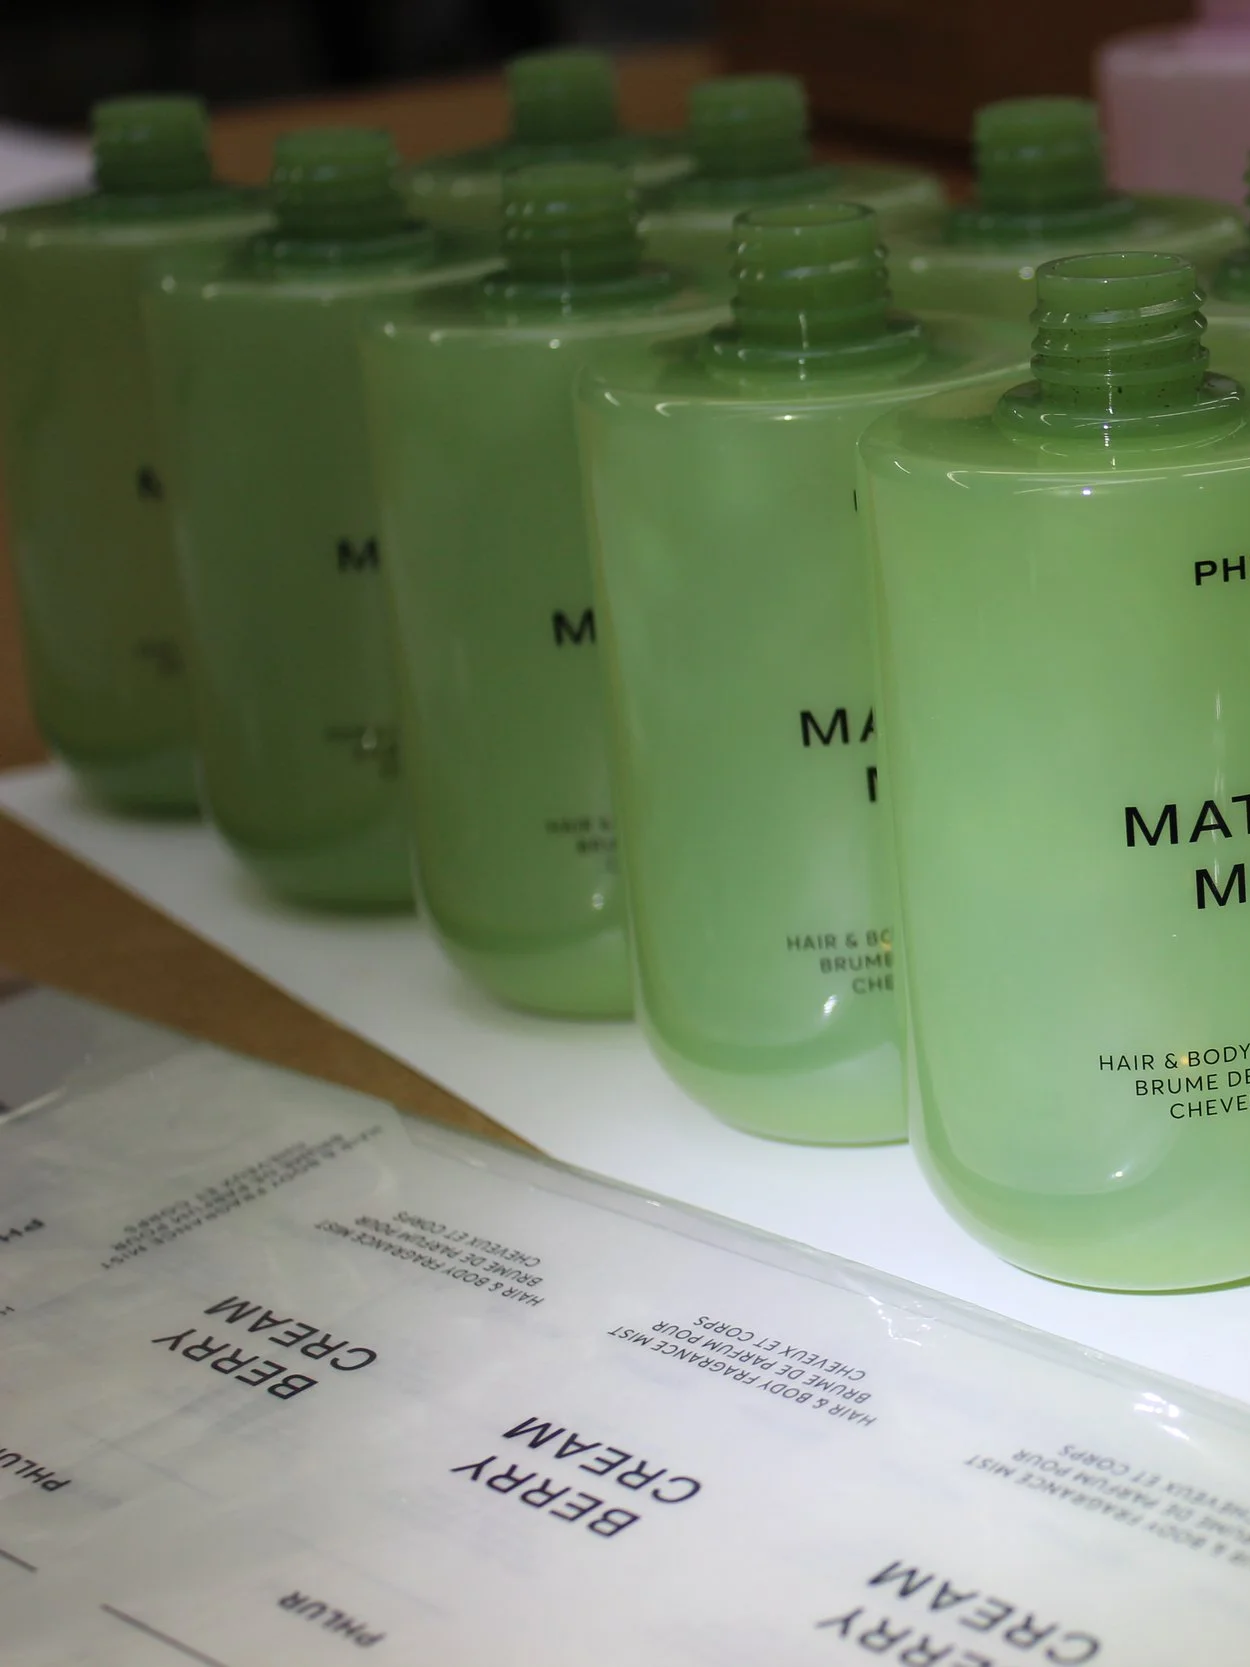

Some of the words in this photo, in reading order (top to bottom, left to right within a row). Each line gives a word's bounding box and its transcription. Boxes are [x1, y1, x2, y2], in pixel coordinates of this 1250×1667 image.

[786, 932, 837, 952] HAIR
[845, 931, 858, 949] &
[819, 951, 894, 974] BRUME
[1099, 1054, 1155, 1071] HAIR
[1164, 1053, 1179, 1070] &
[1188, 1043, 1250, 1068] BODY
[1135, 1073, 1219, 1097] BRUME
[397, 1232, 462, 1260] PARFUM
[442, 1229, 469, 1243] ET
[351, 1232, 446, 1271] FRAGRANCE
[459, 1252, 488, 1268] DE
[464, 1235, 542, 1268] CHEVEUX
[442, 1265, 490, 1287] BODY
[483, 1260, 544, 1288] BRUME
[487, 1281, 504, 1296] &
[500, 1286, 546, 1308] HAIR
[203, 1296, 377, 1371] CREAM
[606, 1325, 654, 1348] MIST
[651, 1319, 704, 1345] POUR
[692, 1314, 755, 1342] CORPS
[701, 1339, 778, 1370] PARFUM
[752, 1337, 781, 1352] ET
[151, 1328, 318, 1400] BERRY
[650, 1340, 761, 1386] FRAGRANCE
[774, 1364, 805, 1382] DE
[777, 1344, 867, 1383] CHEVEUX
[756, 1378, 813, 1405] BODY
[801, 1374, 872, 1405] BRUME
[812, 1397, 830, 1410] &
[828, 1403, 878, 1428] HAIR
[0, 1448, 72, 1492] PHLU
[502, 1416, 702, 1503] CREAM
[449, 1455, 641, 1537] BERRY
[276, 1590, 387, 1648] PHLUR
[867, 1559, 1102, 1666] CREAM
